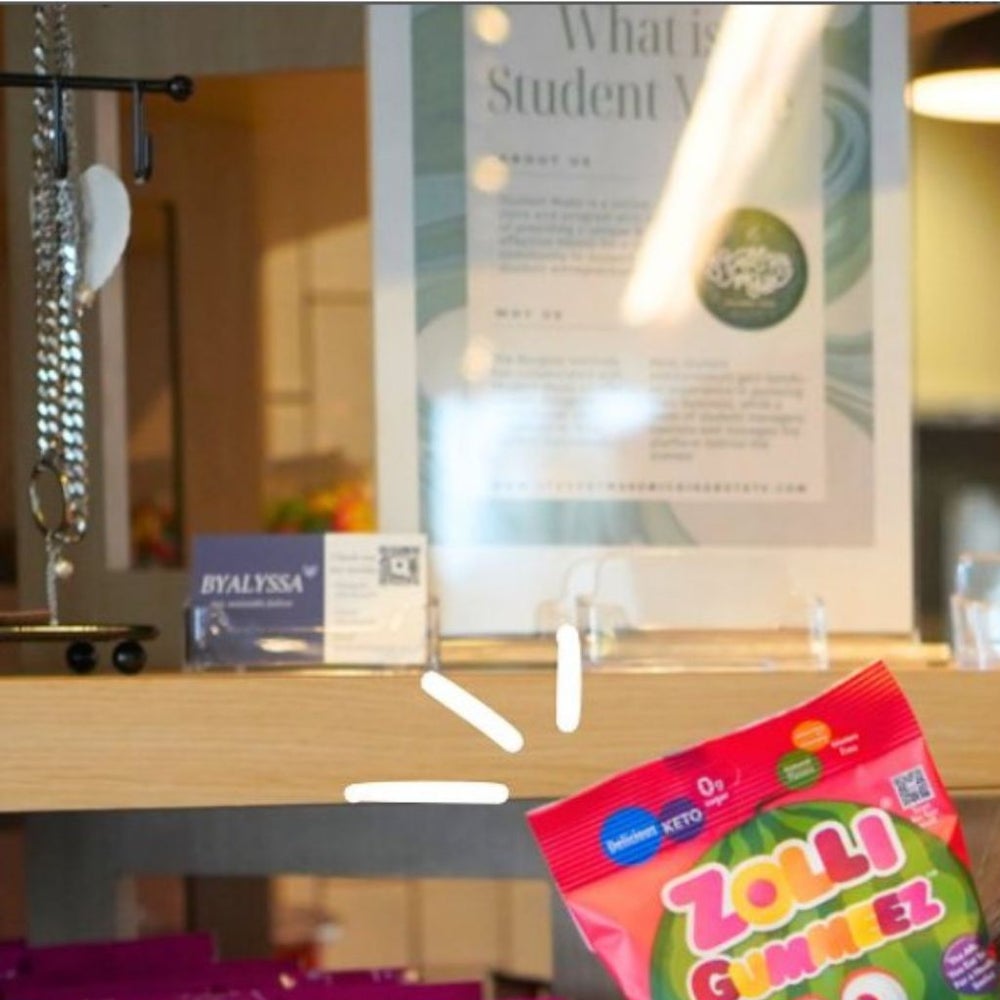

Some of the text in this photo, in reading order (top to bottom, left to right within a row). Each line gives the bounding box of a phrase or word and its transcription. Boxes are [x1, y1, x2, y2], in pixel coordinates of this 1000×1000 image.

[558, 4, 676, 55] What
[488, 66, 658, 119] Student
[201, 571, 304, 594] BYALYSSA
[660, 808, 703, 836] KETO
